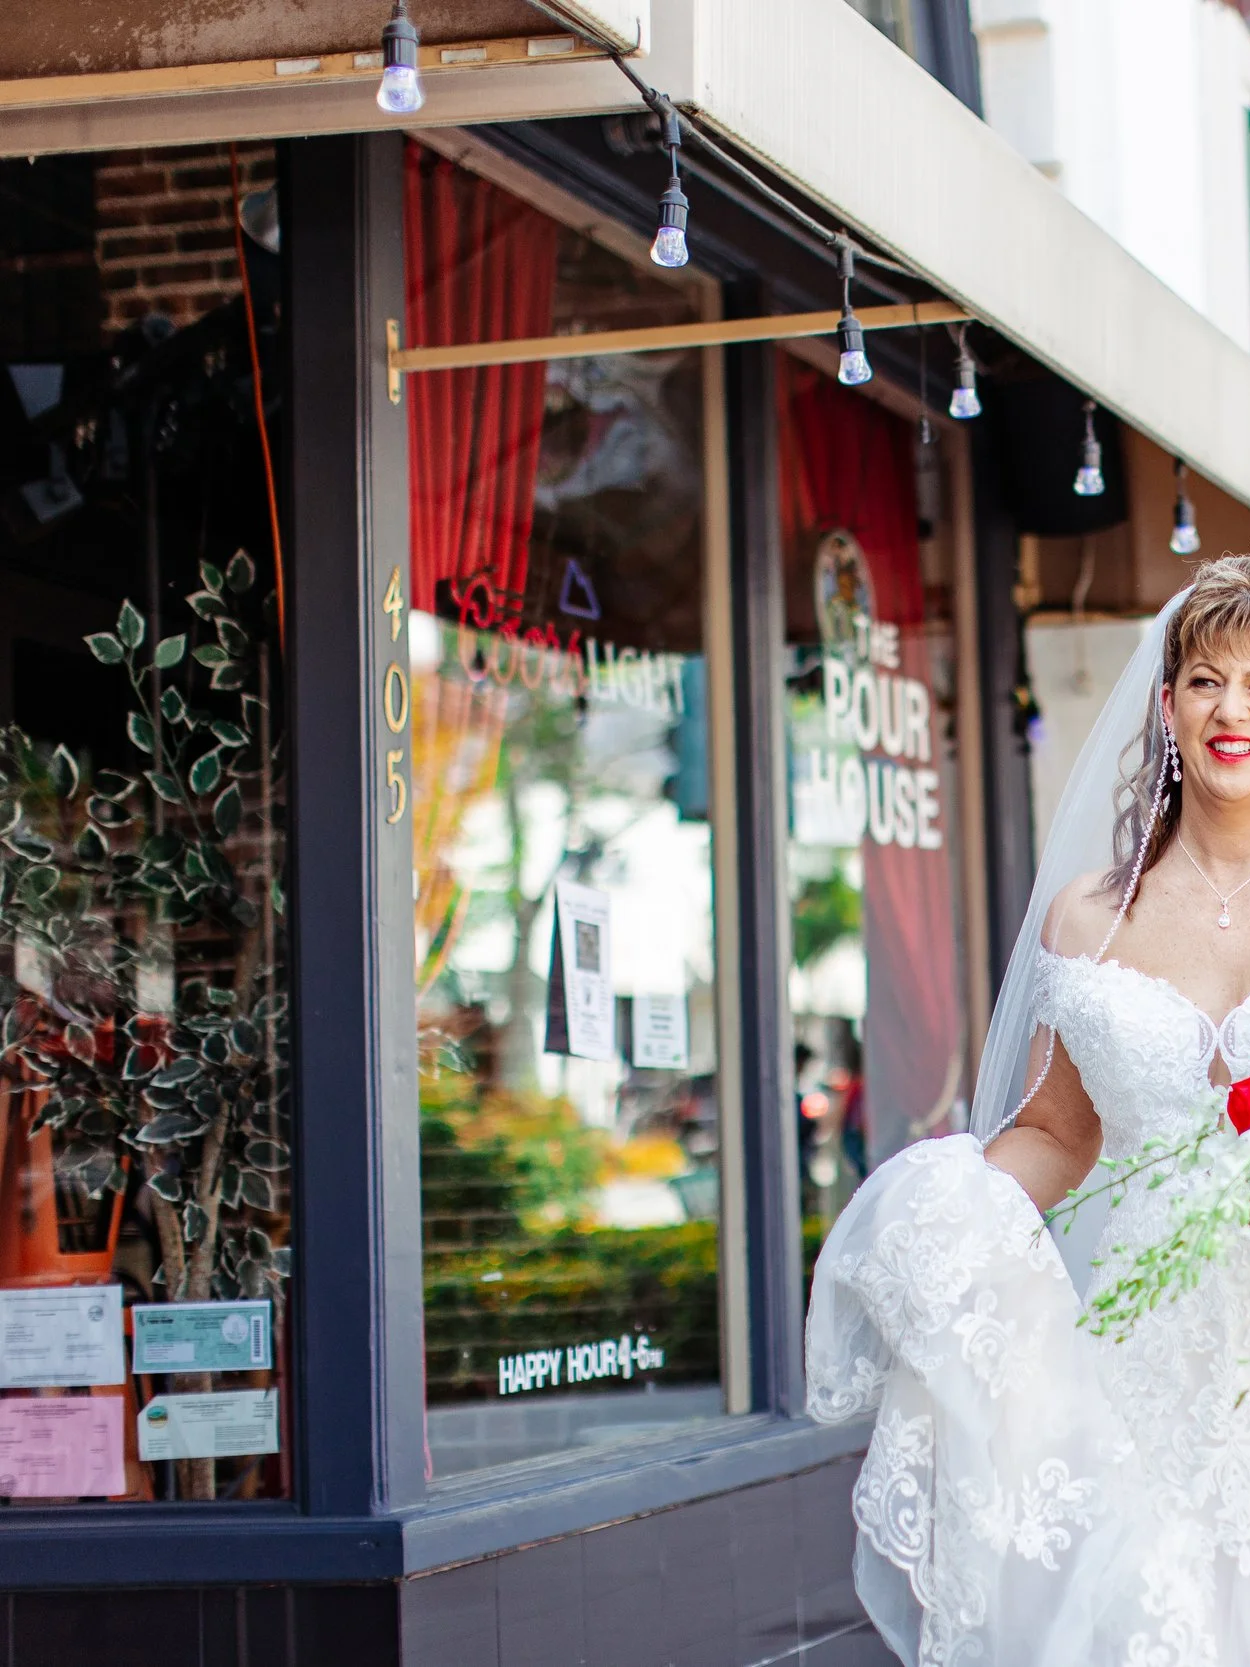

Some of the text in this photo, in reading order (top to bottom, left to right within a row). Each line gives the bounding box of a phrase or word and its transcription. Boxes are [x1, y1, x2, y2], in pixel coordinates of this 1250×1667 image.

[586, 636, 684, 715] LIGHT
[853, 612, 900, 669] THE
[382, 564, 408, 826] 405
[823, 656, 932, 763] POUR
[808, 748, 943, 850] HOUSE
[498, 1349, 562, 1395] HAPPY
[567, 1340, 618, 1383] HOUR
